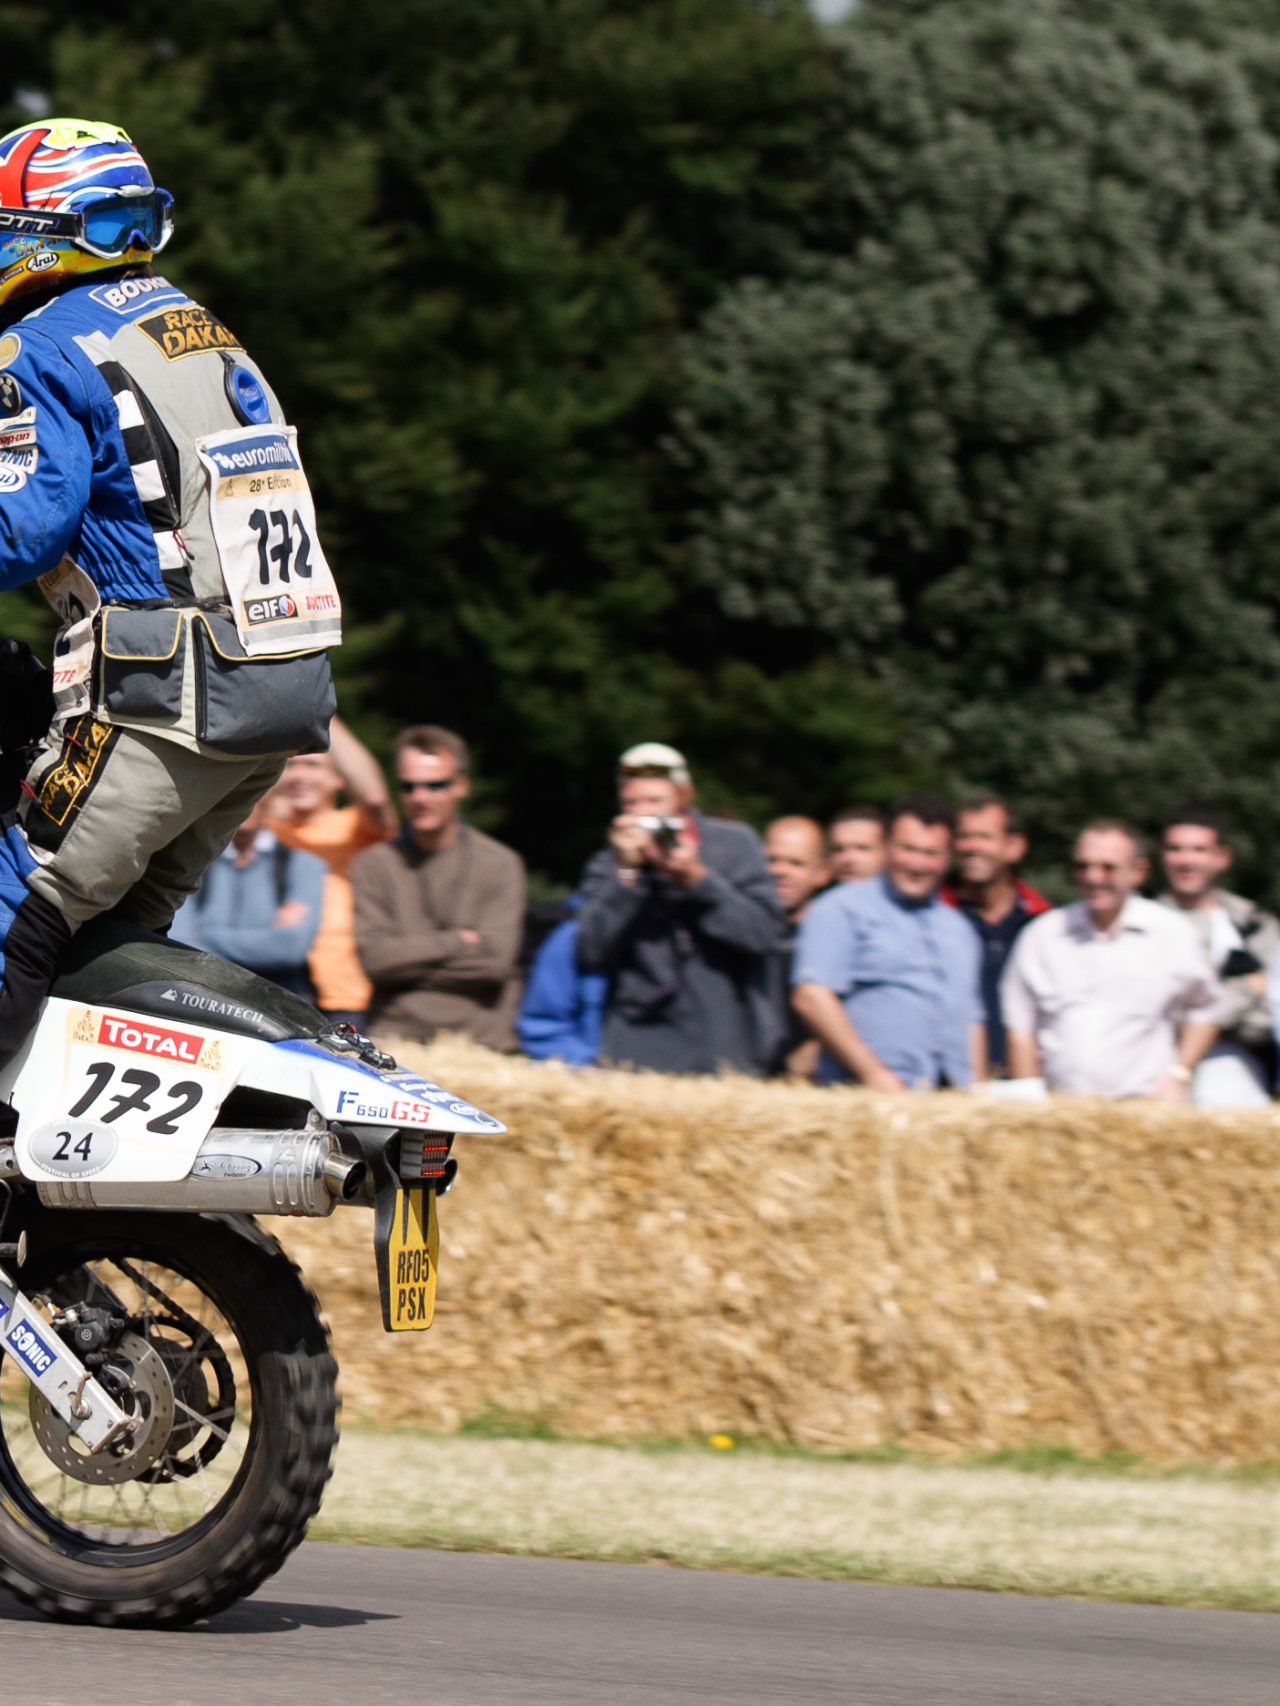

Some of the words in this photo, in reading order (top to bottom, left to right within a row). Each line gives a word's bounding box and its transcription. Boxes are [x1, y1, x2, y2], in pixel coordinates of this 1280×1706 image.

[30, 253, 55, 271] Arai
[164, 311, 212, 330] RACE
[248, 508, 313, 585] 172
[248, 598, 279, 620] elf
[181, 991, 265, 1024] TOURATECH
[105, 1019, 195, 1060] TOTAL
[68, 1061, 203, 1135] 172
[52, 1131, 93, 1161] 24
[396, 1248, 429, 1285] RF05
[396, 1285, 426, 1322] PSX
[11, 1324, 51, 1371] SONIC
